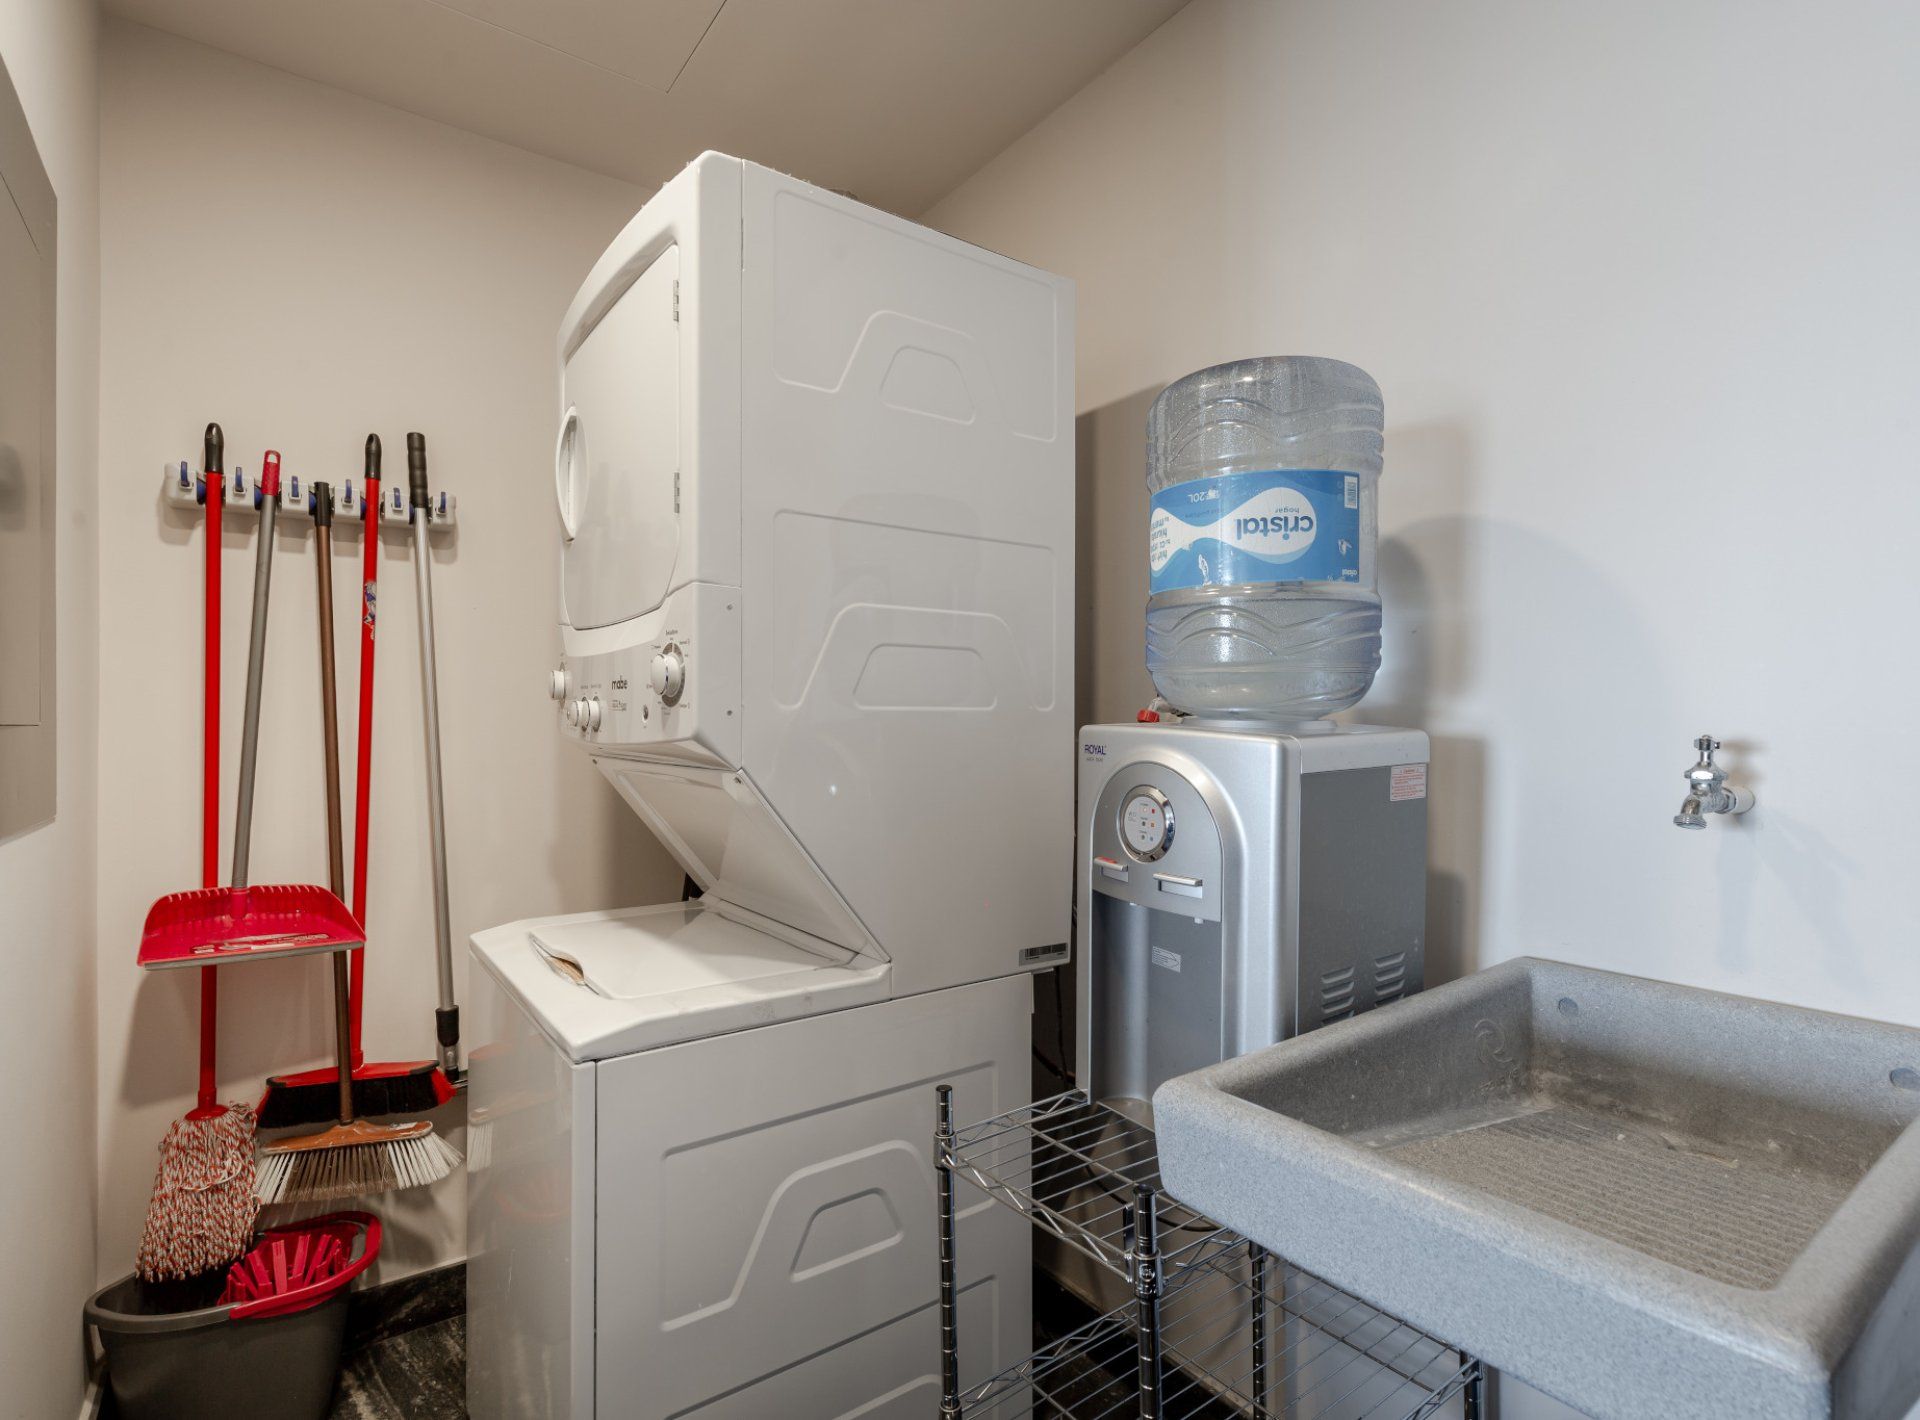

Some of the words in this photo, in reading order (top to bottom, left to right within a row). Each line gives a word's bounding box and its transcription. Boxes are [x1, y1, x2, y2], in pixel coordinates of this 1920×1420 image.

[1188, 491, 1207, 503] 20L
[1275, 506, 1300, 514] hogar
[1236, 515, 1314, 541] cristal
[611, 675, 629, 690] mabe
[1084, 744, 1107, 755] ROYAL
